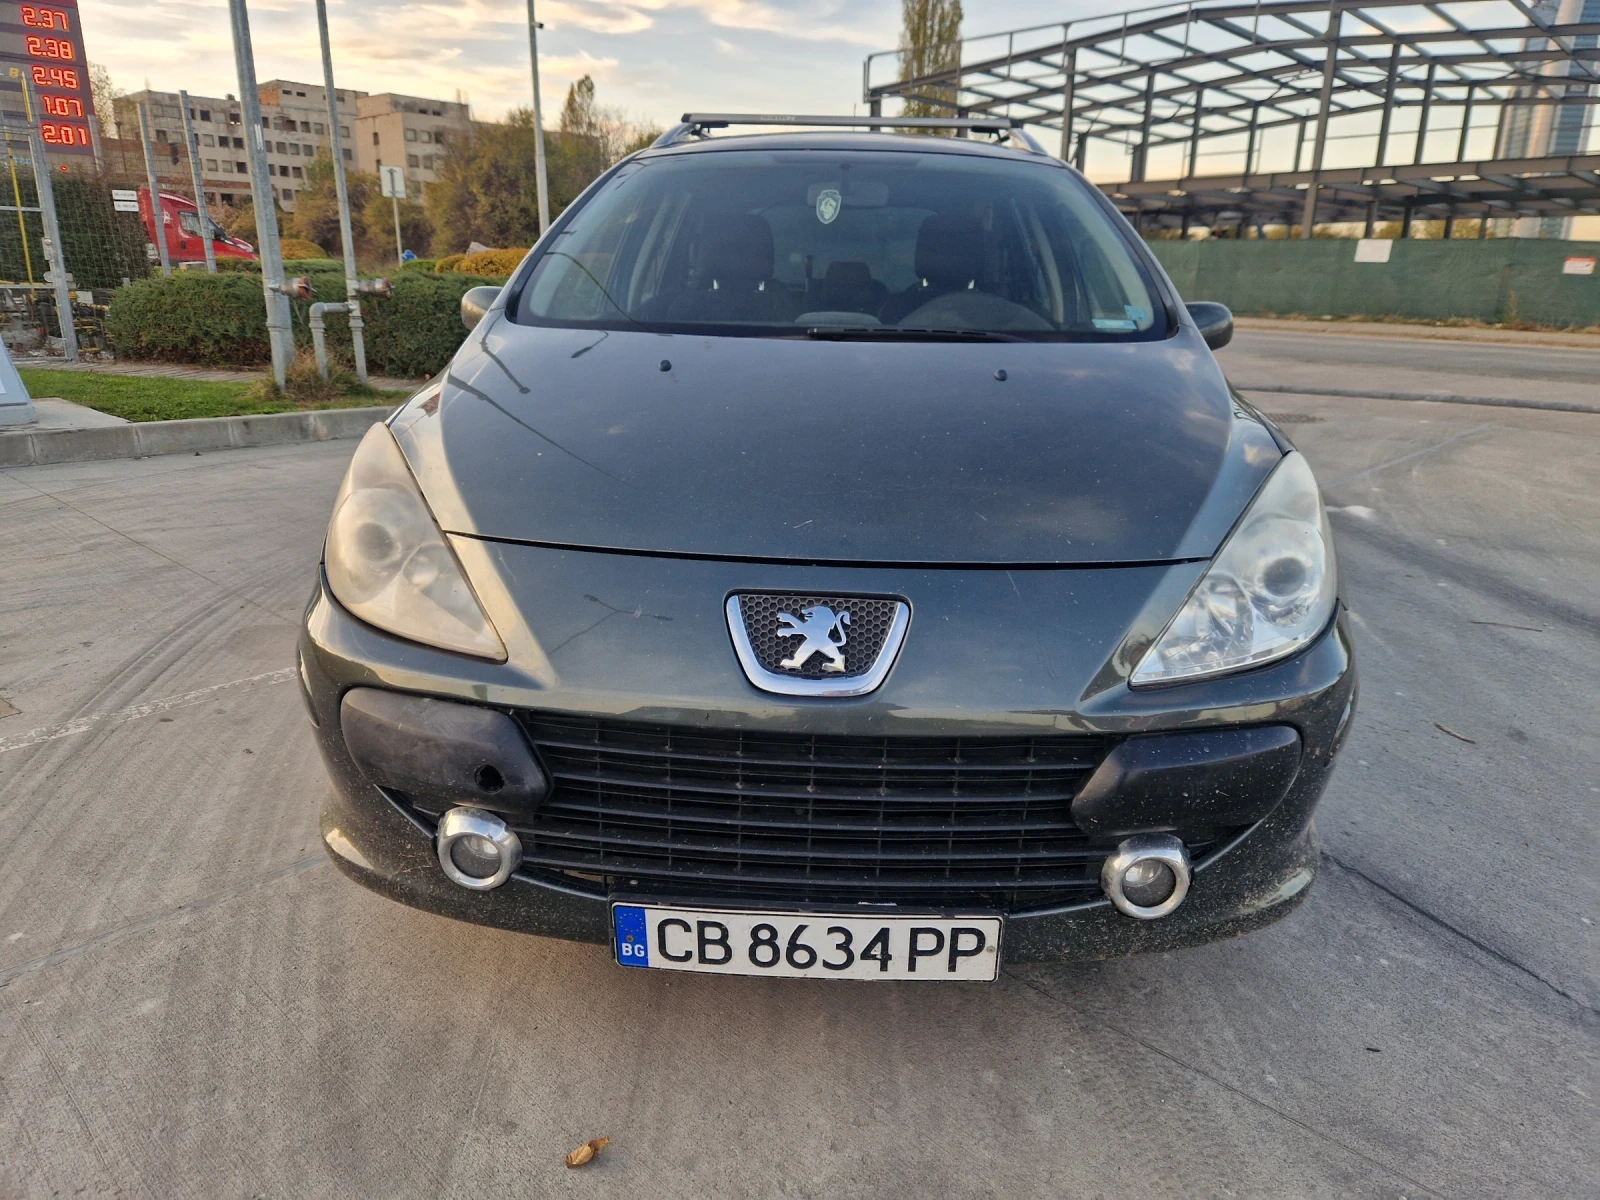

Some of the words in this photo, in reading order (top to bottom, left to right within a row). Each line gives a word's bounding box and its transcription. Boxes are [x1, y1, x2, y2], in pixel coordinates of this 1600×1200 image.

[22, 6, 69, 31] 2.37
[27, 37, 74, 60] 2.38
[31, 66, 78, 90] 2.45
[43, 96, 83, 118] 1.07
[621, 943, 645, 957] BG
[656, 917, 733, 966] CB
[747, 923, 893, 973] 8634
[906, 926, 986, 973] PP
